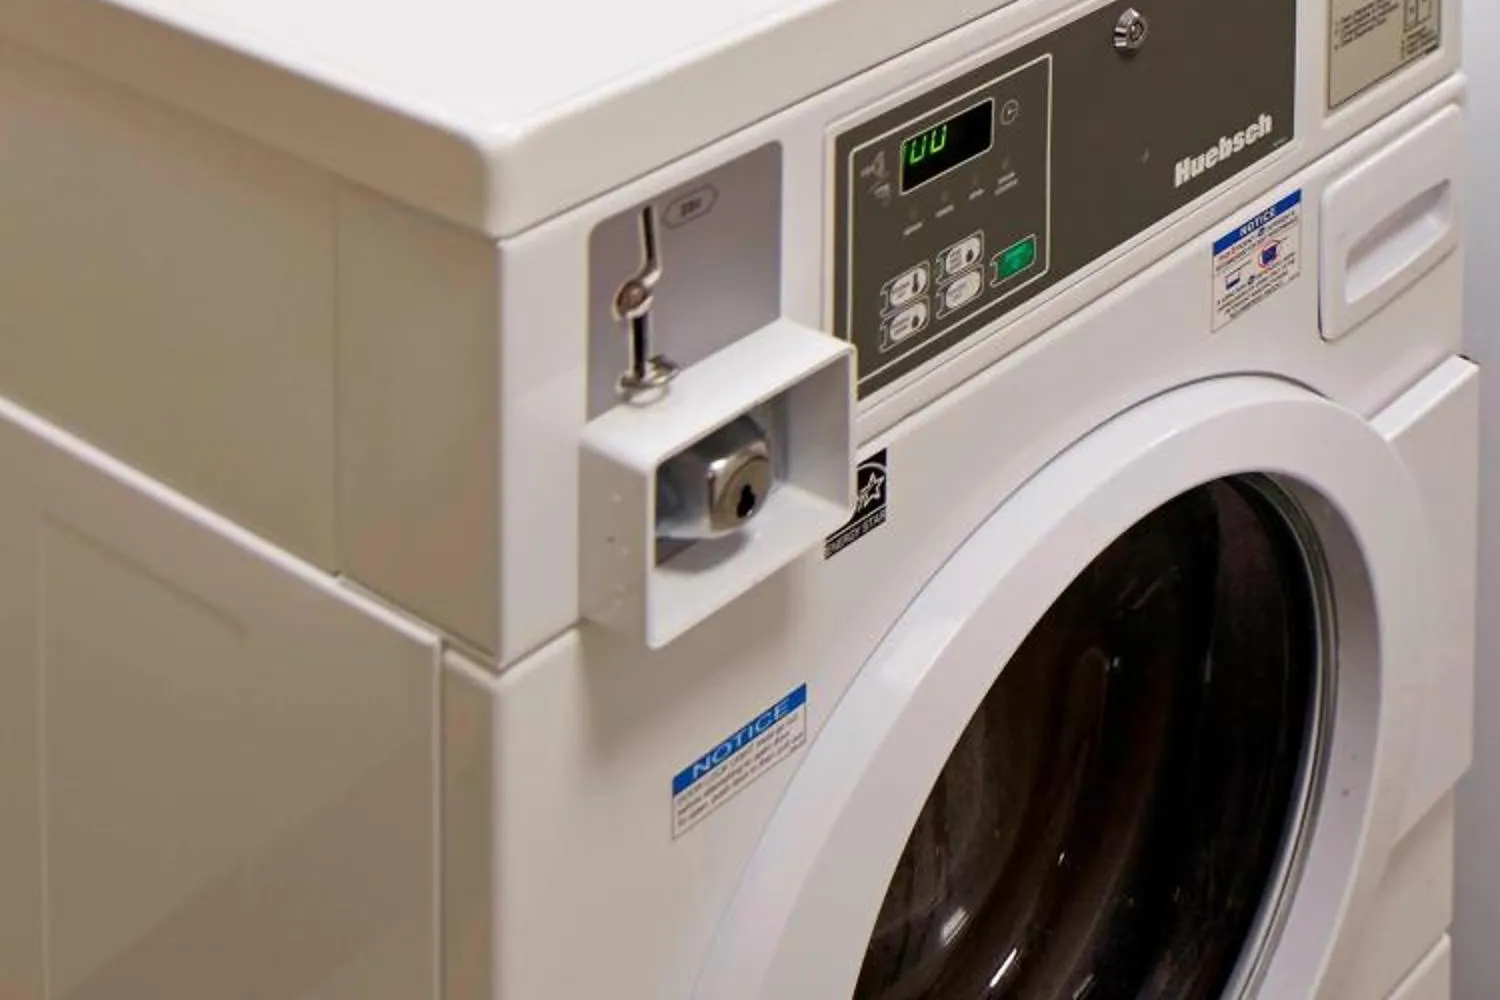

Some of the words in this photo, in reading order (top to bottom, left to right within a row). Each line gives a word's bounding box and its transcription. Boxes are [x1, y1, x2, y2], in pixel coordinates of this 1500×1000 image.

[1174, 113, 1273, 188] Huebsch
[1240, 206, 1277, 237] NOTICE
[691, 698, 790, 780] NOTICE
